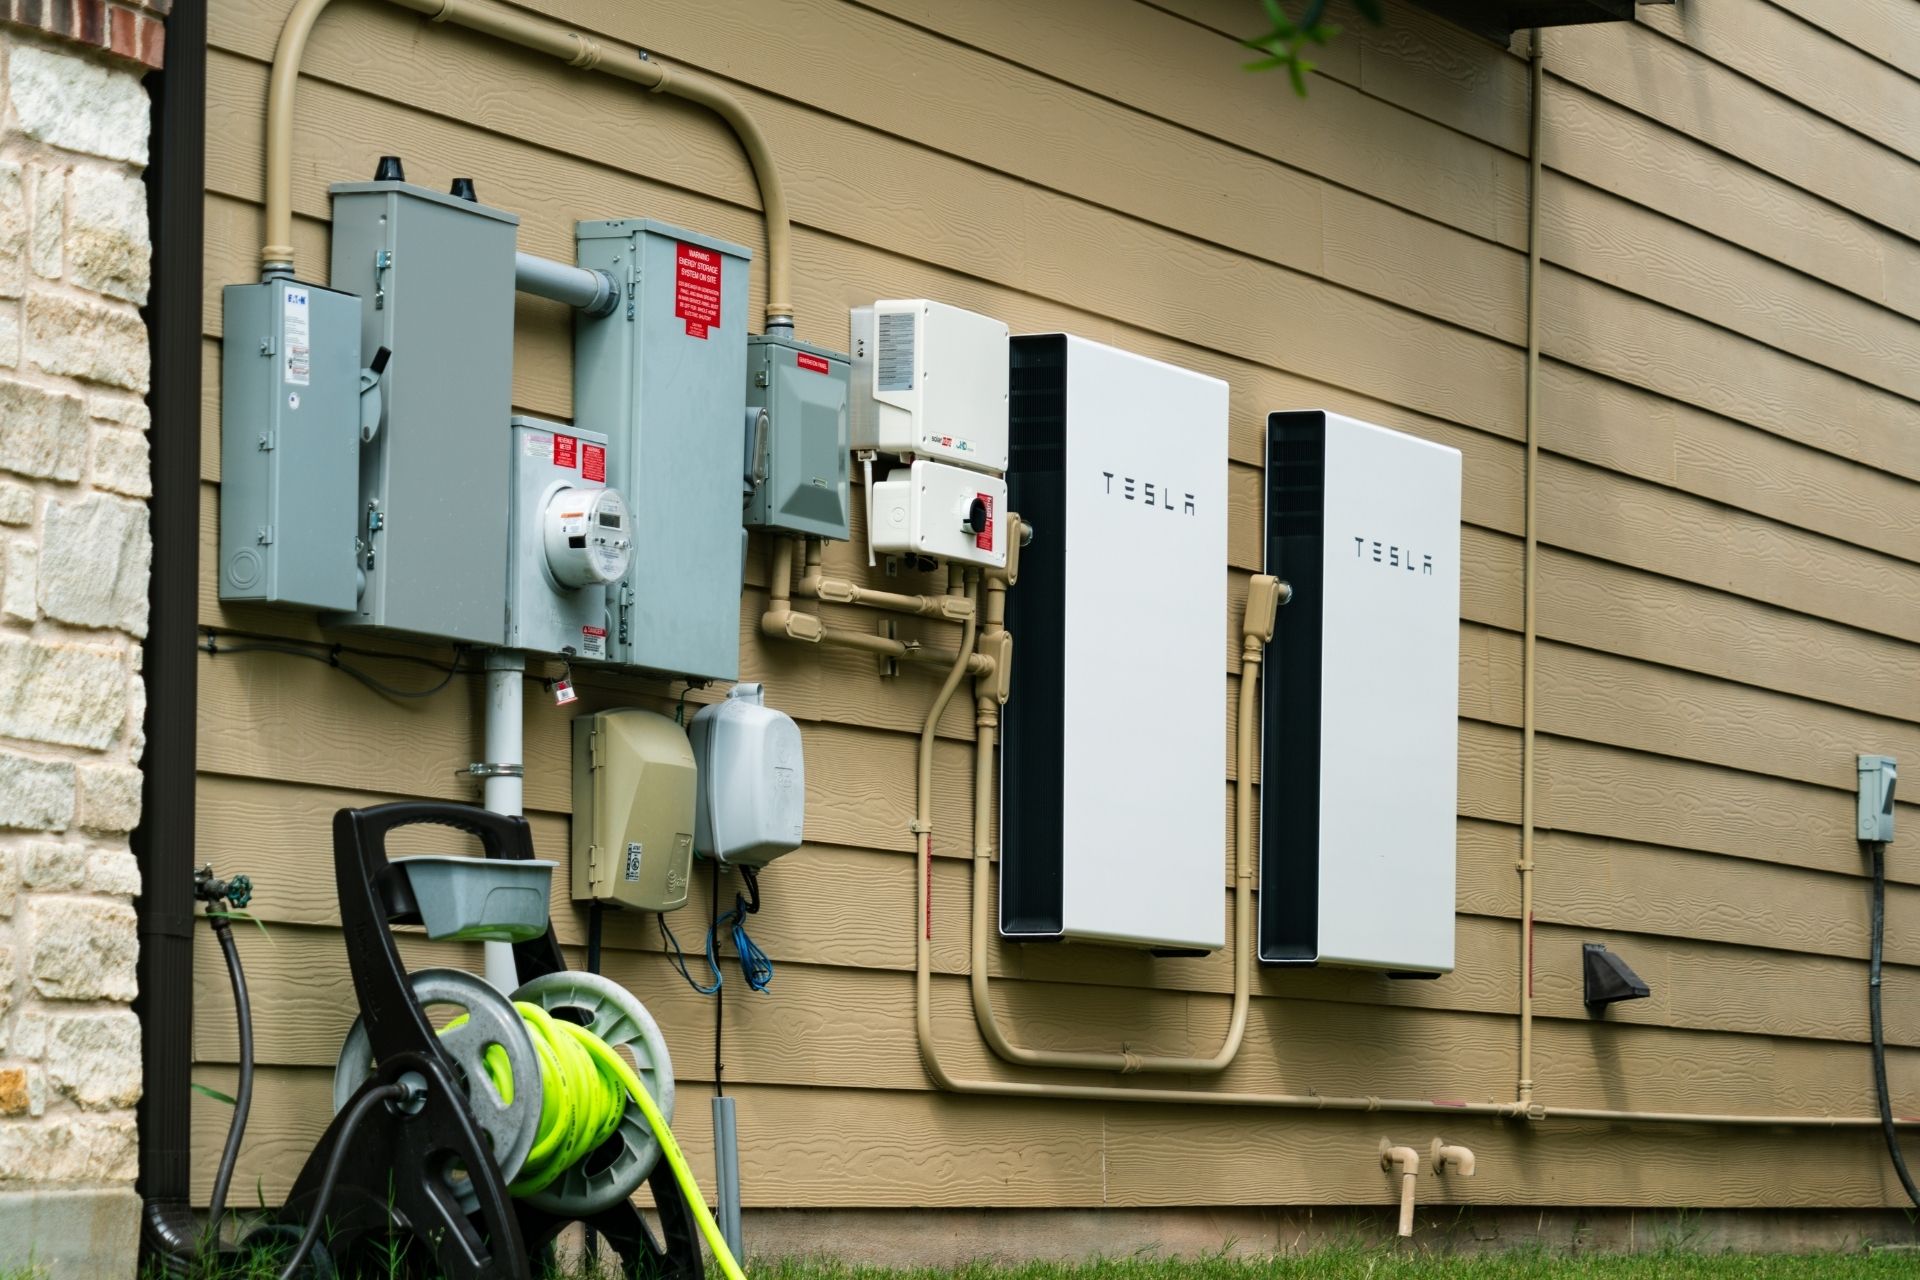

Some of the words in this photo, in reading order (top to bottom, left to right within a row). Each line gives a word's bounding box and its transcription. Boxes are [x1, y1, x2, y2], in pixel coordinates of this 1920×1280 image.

[689, 249, 710, 262] WARNING
[679, 256, 697, 268] ENERGY
[697, 262, 719, 275] STORAGE
[681, 267, 699, 279] SYSTEM
[700, 272, 707, 281] ON
[707, 275, 717, 285] SITE
[1102, 471, 1195, 516] TESLA
[1354, 536, 1432, 576] TESLA
